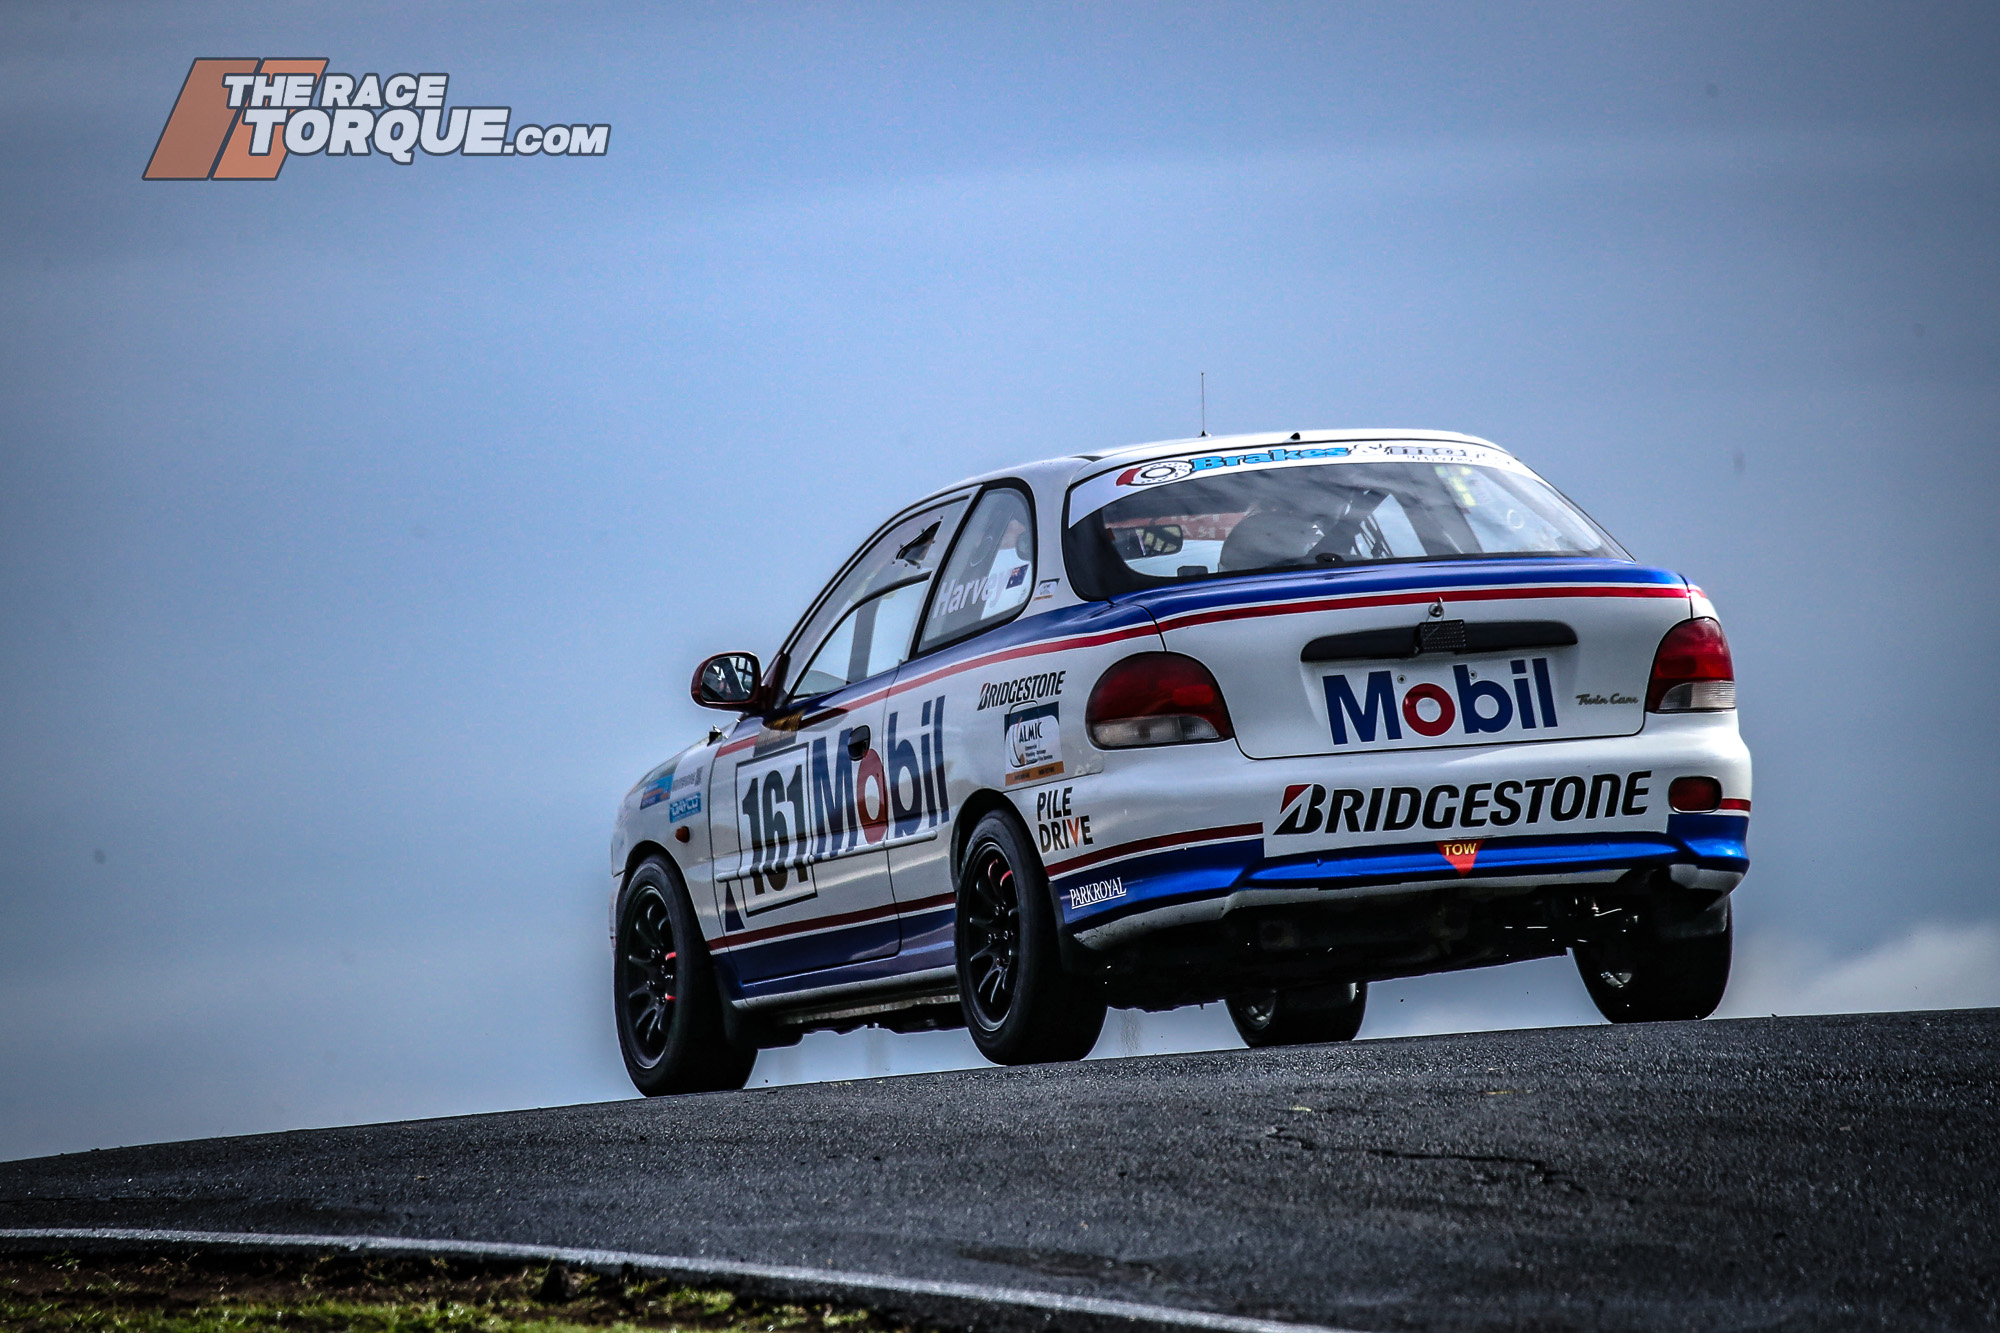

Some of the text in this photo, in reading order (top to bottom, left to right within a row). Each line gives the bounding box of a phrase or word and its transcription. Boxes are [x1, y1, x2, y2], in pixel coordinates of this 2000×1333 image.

[1190, 447, 1350, 471] Brakes
[933, 572, 1004, 619] Harvey
[977, 671, 1066, 711] BRIDGESTONE
[1322, 657, 1558, 746] Mobil
[1576, 692, 1639, 706] Twin Cam
[1019, 721, 1043, 743] ALMIC
[812, 695, 950, 858] Mobil
[1037, 786, 1073, 821] PILE
[1273, 770, 1652, 836] BRIDGESTONE
[742, 764, 809, 896] 161
[1038, 815, 1093, 853] DRIVE
[1443, 843, 1477, 856] TOW
[1069, 876, 1127, 908] PARKROYAL
